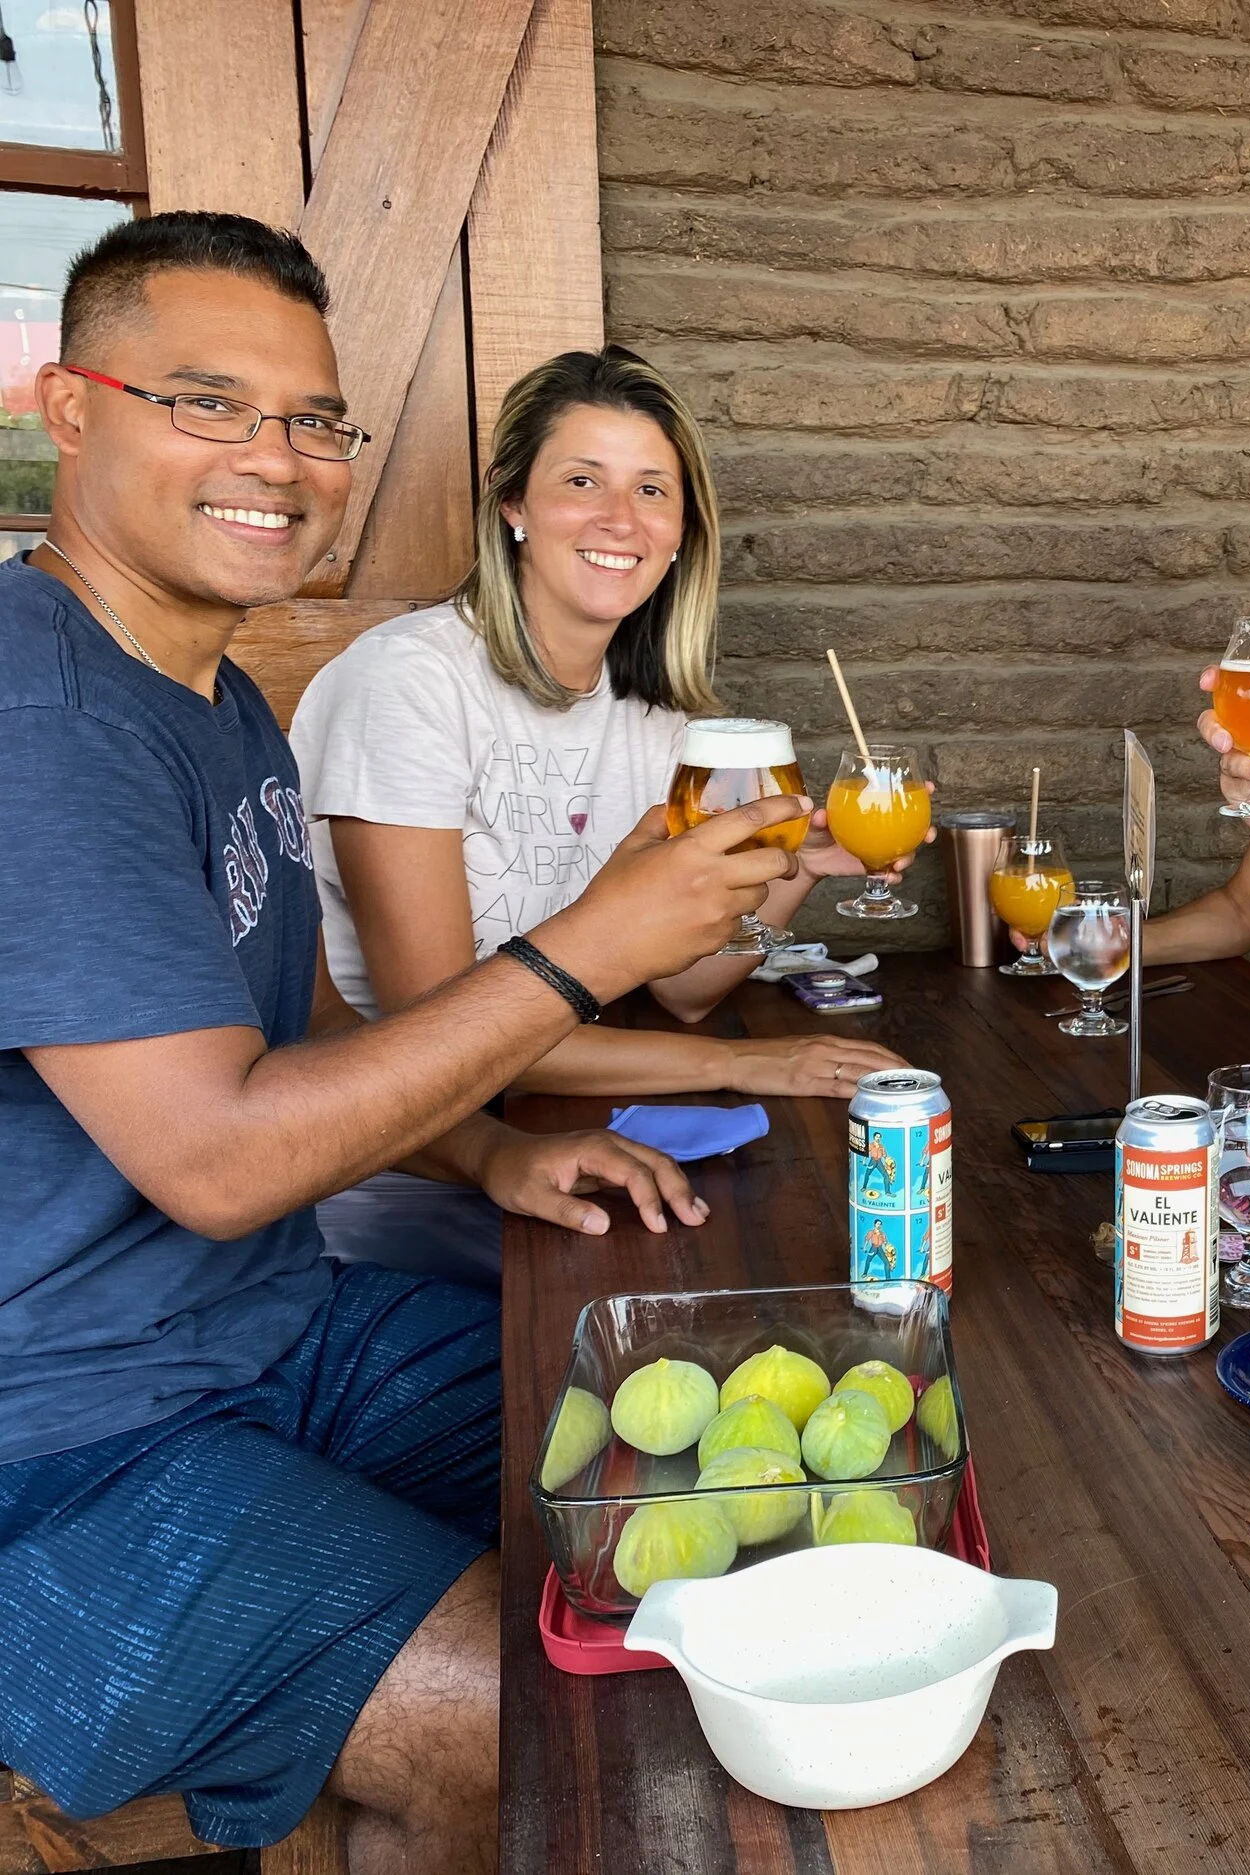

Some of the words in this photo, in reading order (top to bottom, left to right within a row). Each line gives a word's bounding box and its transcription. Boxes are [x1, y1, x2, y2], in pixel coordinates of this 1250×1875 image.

[1126, 1158, 1160, 1180] SONOMA
[1160, 1160, 1203, 1176] SPRINGS
[868, 1199, 896, 1208] VALIENTE
[1155, 1196, 1171, 1210] EL
[915, 1217, 923, 1225] 12
[1130, 1207, 1198, 1226] VALIENTE
